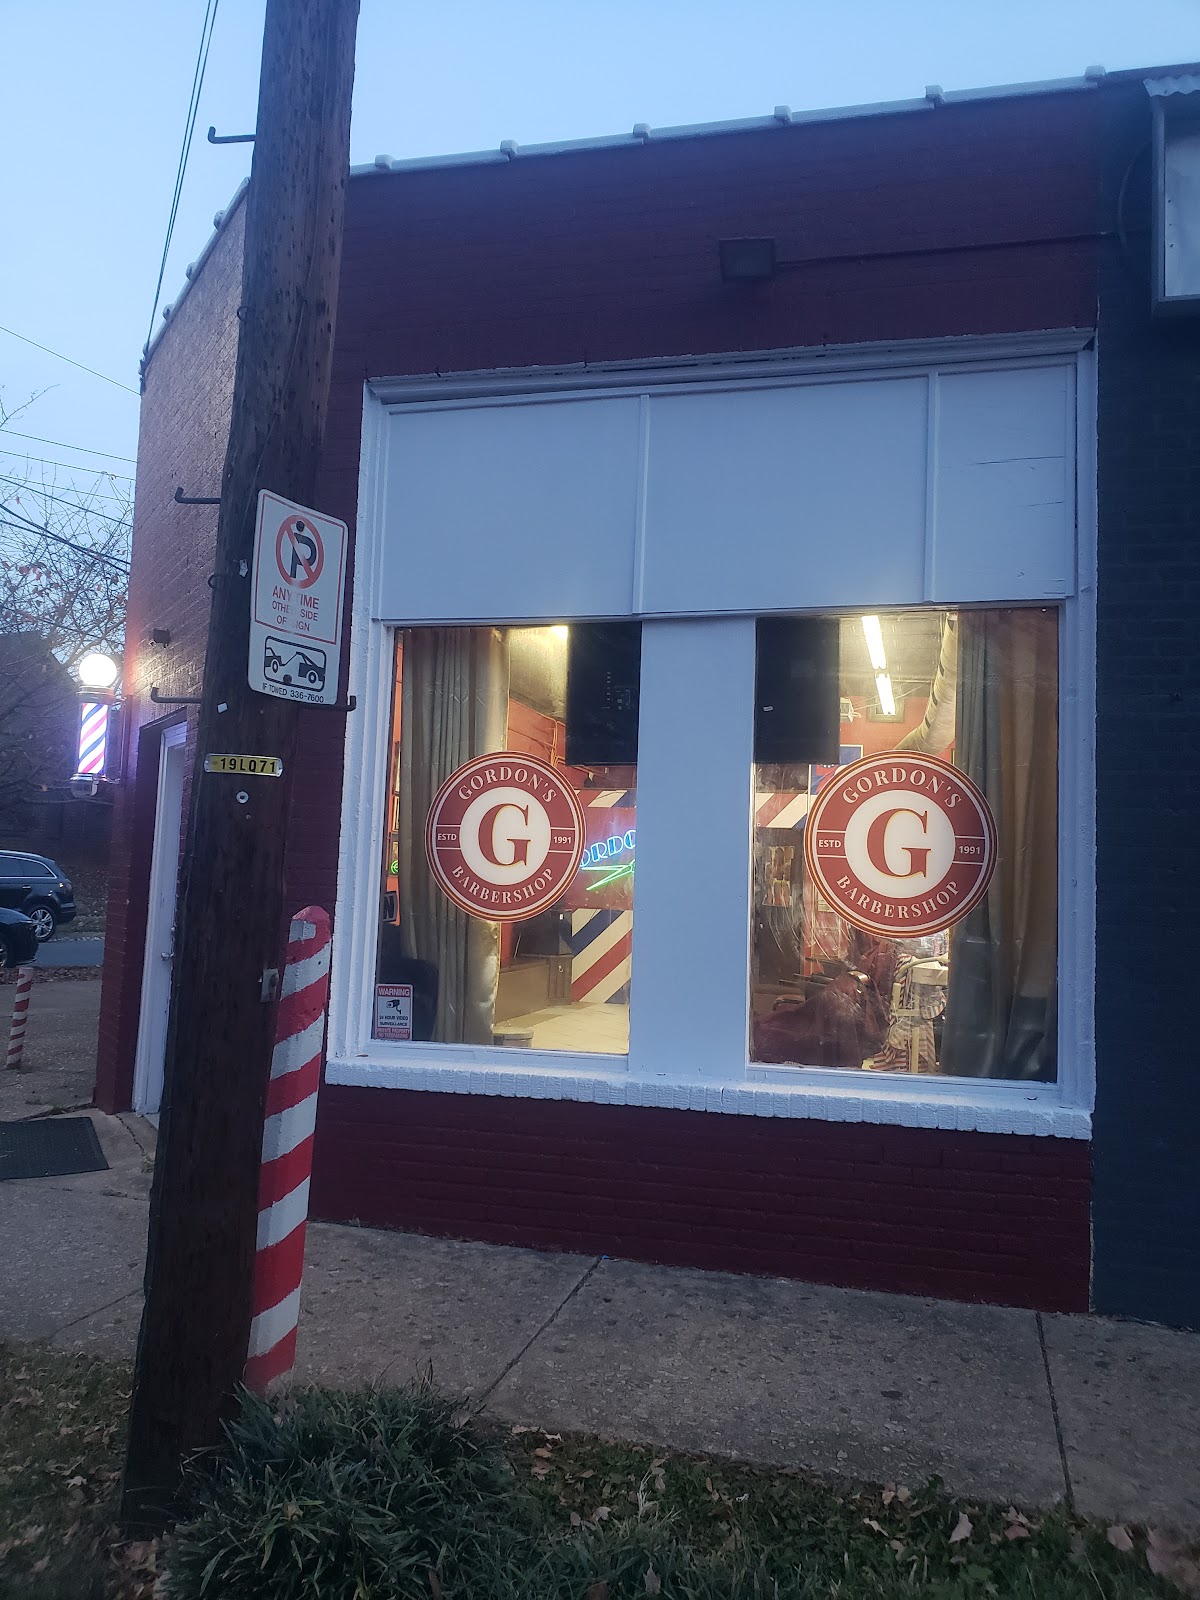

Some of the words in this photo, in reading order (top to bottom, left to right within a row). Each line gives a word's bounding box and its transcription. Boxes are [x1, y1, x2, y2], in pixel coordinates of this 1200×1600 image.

[271, 600, 293, 614] OTHE
[299, 608, 319, 622] SIDE
[272, 585, 292, 602] ANY
[297, 592, 320, 610] IME
[276, 614, 288, 625] OF
[292, 619, 311, 632] IGN
[269, 684, 288, 696] TOWED
[290, 689, 324, 703] 336-7600
[220, 757, 277, 773] 19LQ71
[458, 766, 558, 804] GORDON'S
[842, 767, 962, 808] GORDON'S
[437, 832, 457, 842] ESTD
[478, 803, 531, 867] G
[553, 835, 572, 845] 1991
[818, 839, 842, 849] ESTD
[866, 807, 932, 878] G
[958, 845, 981, 855] 1991
[451, 865, 554, 904] BARBERSHOP
[836, 875, 960, 919] BARBERSHOP
[378, 988, 410, 996] WARNING
